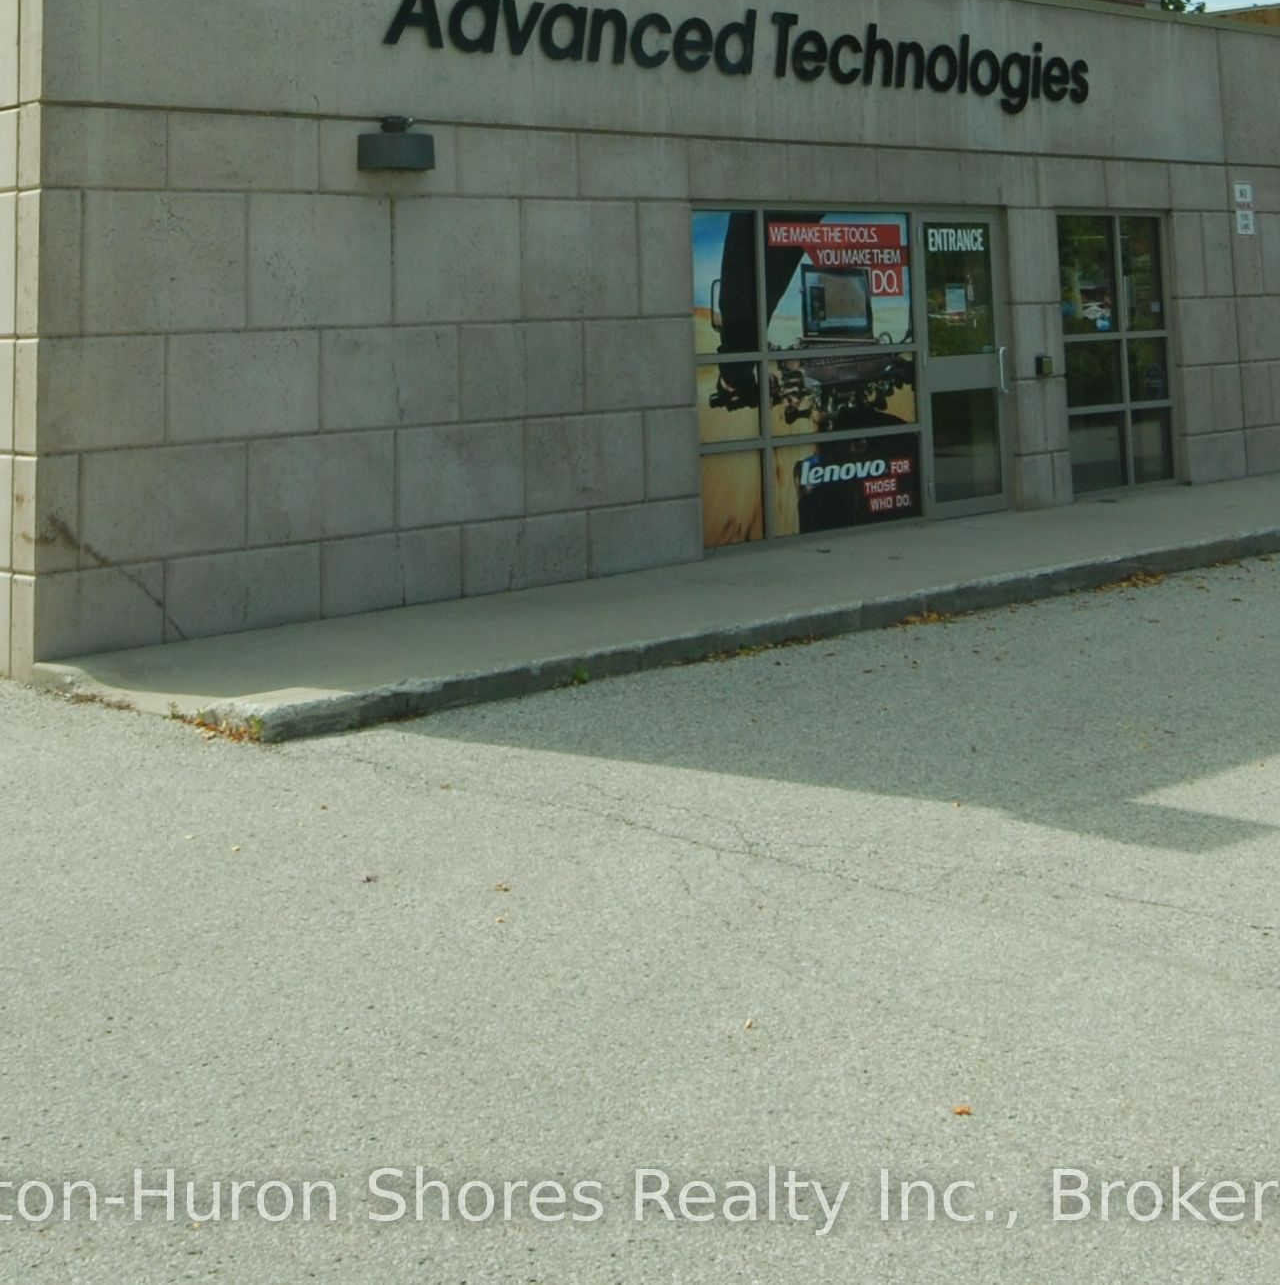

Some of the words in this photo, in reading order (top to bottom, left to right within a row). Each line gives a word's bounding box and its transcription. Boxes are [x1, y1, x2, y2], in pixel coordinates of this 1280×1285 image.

[770, 11, 1089, 114] Technologies
[769, 226, 789, 243] WE
[790, 226, 821, 243] MAKE
[823, 227, 842, 243] THE
[927, 228, 985, 252] ENTRANCE
[817, 249, 841, 265] YOU
[841, 249, 872, 265] MAKE
[873, 249, 901, 265] THEM
[871, 269, 899, 294] DO.
[801, 459, 886, 486] lenovo
[891, 461, 909, 473] FOR
[865, 479, 896, 493] THOSE
[871, 497, 892, 510] WHO
[895, 494, 912, 507] DO.
